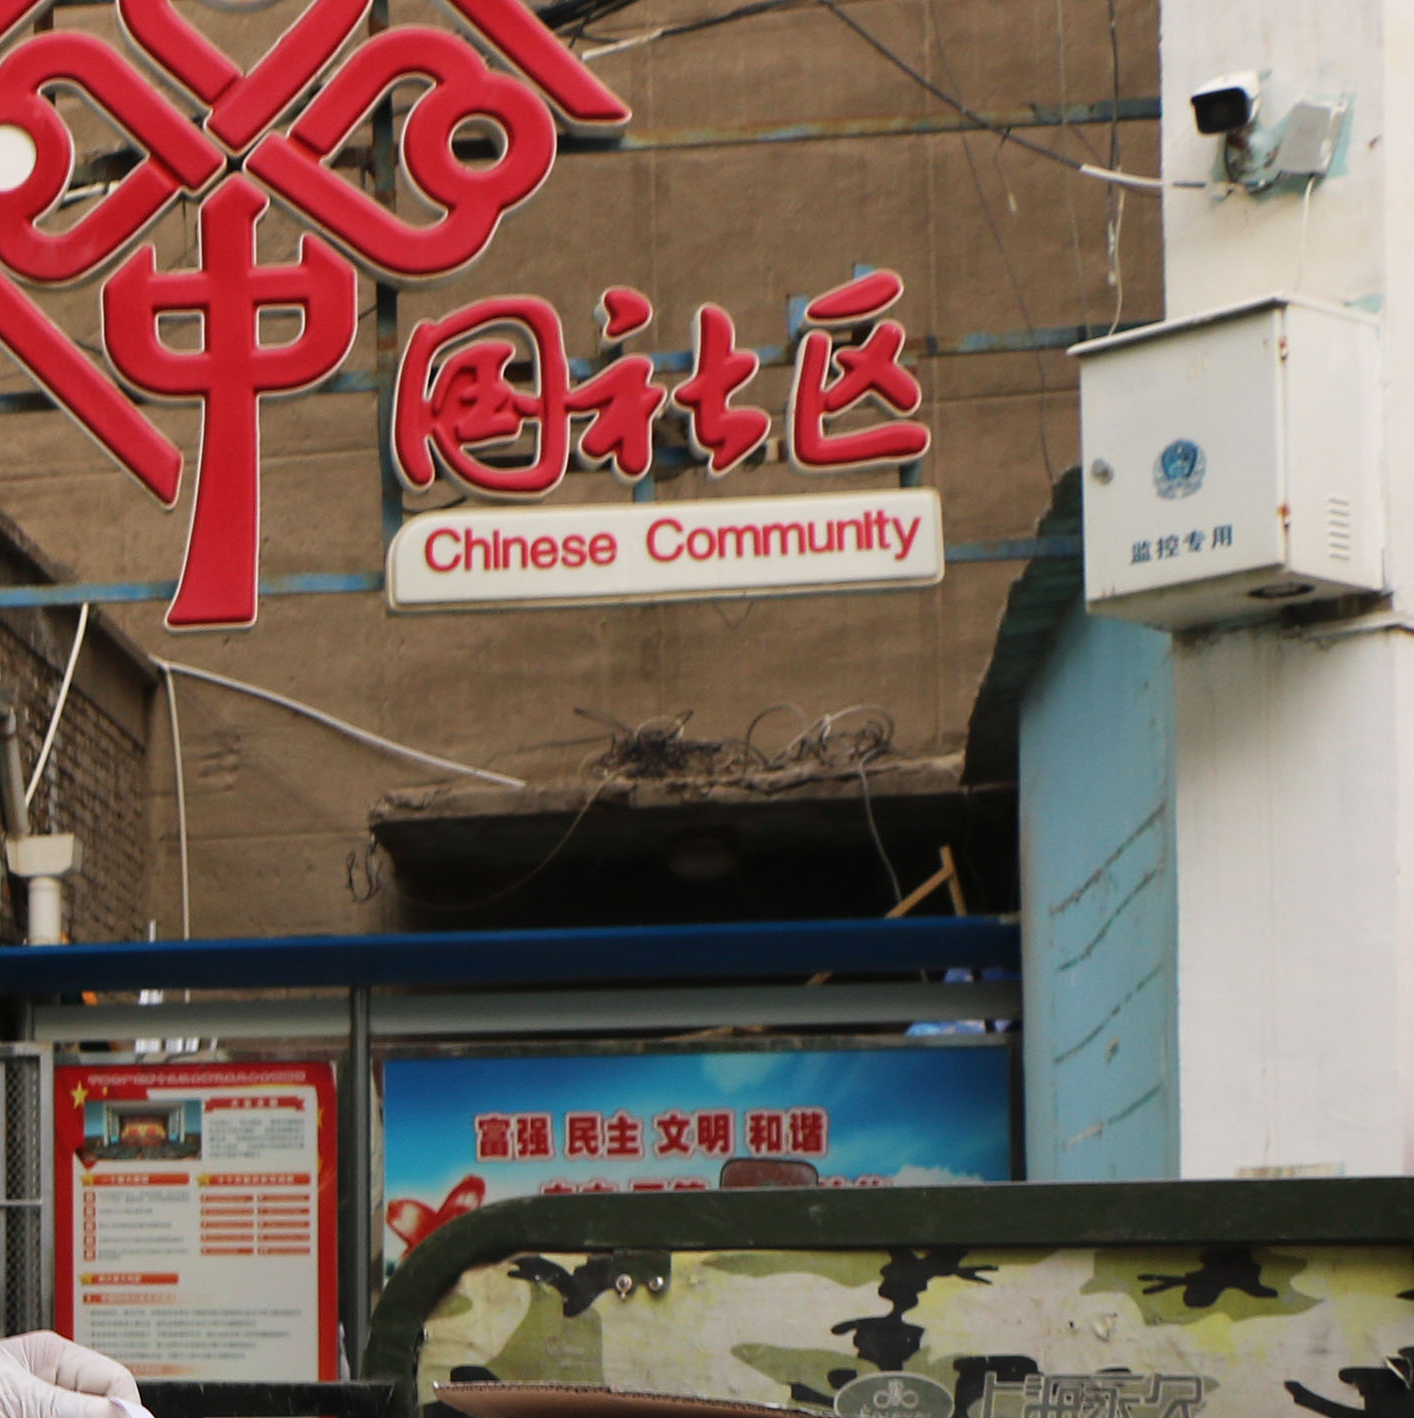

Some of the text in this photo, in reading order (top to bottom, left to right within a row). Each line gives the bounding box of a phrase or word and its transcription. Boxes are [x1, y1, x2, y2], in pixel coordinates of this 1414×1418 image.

[424, 510, 923, 573] Chinese Community
[1130, 523, 1234, 565] 监控专用
[474, 1107, 828, 1161] 富强 民主 文明 和谐
